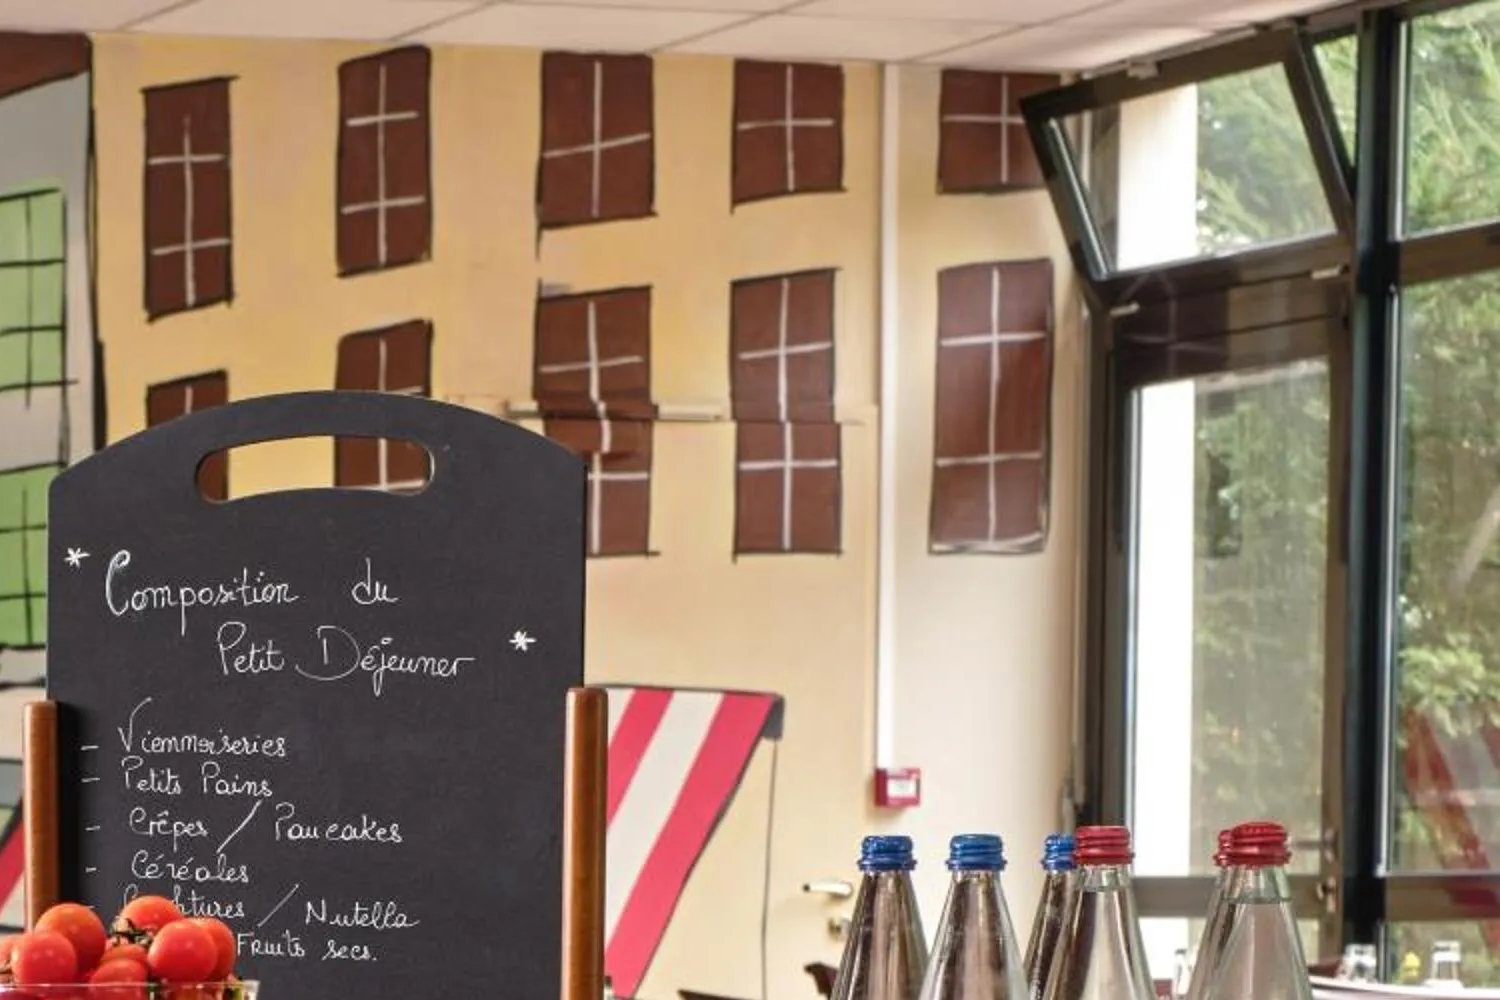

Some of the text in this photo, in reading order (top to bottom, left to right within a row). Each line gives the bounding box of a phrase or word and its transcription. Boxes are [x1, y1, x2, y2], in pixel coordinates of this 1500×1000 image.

[105, 549, 400, 638] Composition du
[216, 621, 476, 697] Petit Déjeuner
[117, 697, 286, 757] Viennoiseries
[120, 755, 273, 797] Petits Pains
[129, 806, 209, 852] Crêpes
[131, 849, 249, 884] Céréales
[305, 898, 420, 930] Nutella
